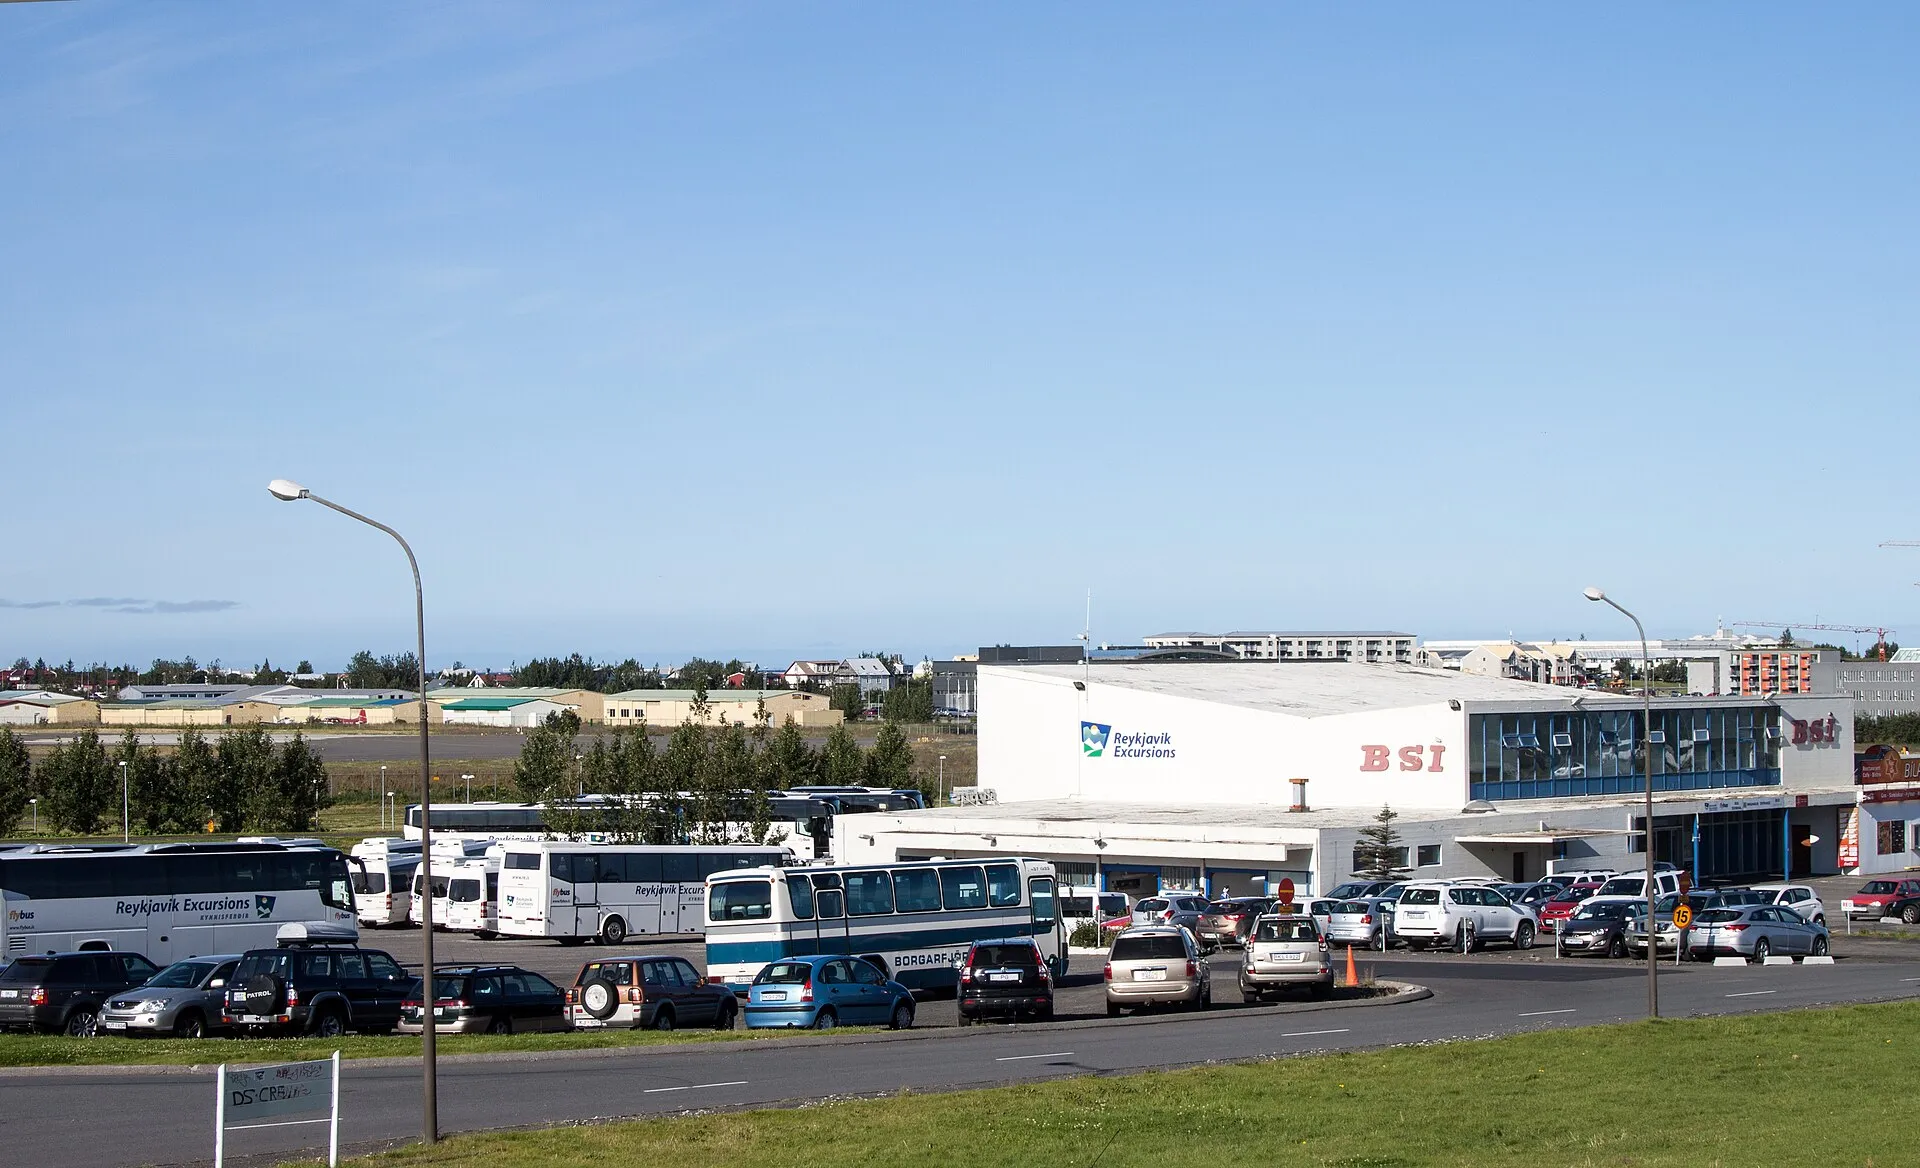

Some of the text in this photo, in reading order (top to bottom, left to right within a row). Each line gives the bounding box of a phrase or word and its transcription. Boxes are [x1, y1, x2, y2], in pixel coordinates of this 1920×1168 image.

[1113, 732, 1171, 747] Reykjavik
[1113, 745, 1176, 759] Excursions
[552, 888, 571, 898] flybus
[635, 884, 677, 897] Reykjavik
[116, 896, 250, 917] Reykjavik Excursions
[9, 910, 35, 922] flybus
[1675, 909, 1689, 924] 15
[246, 990, 272, 999] PATROL
